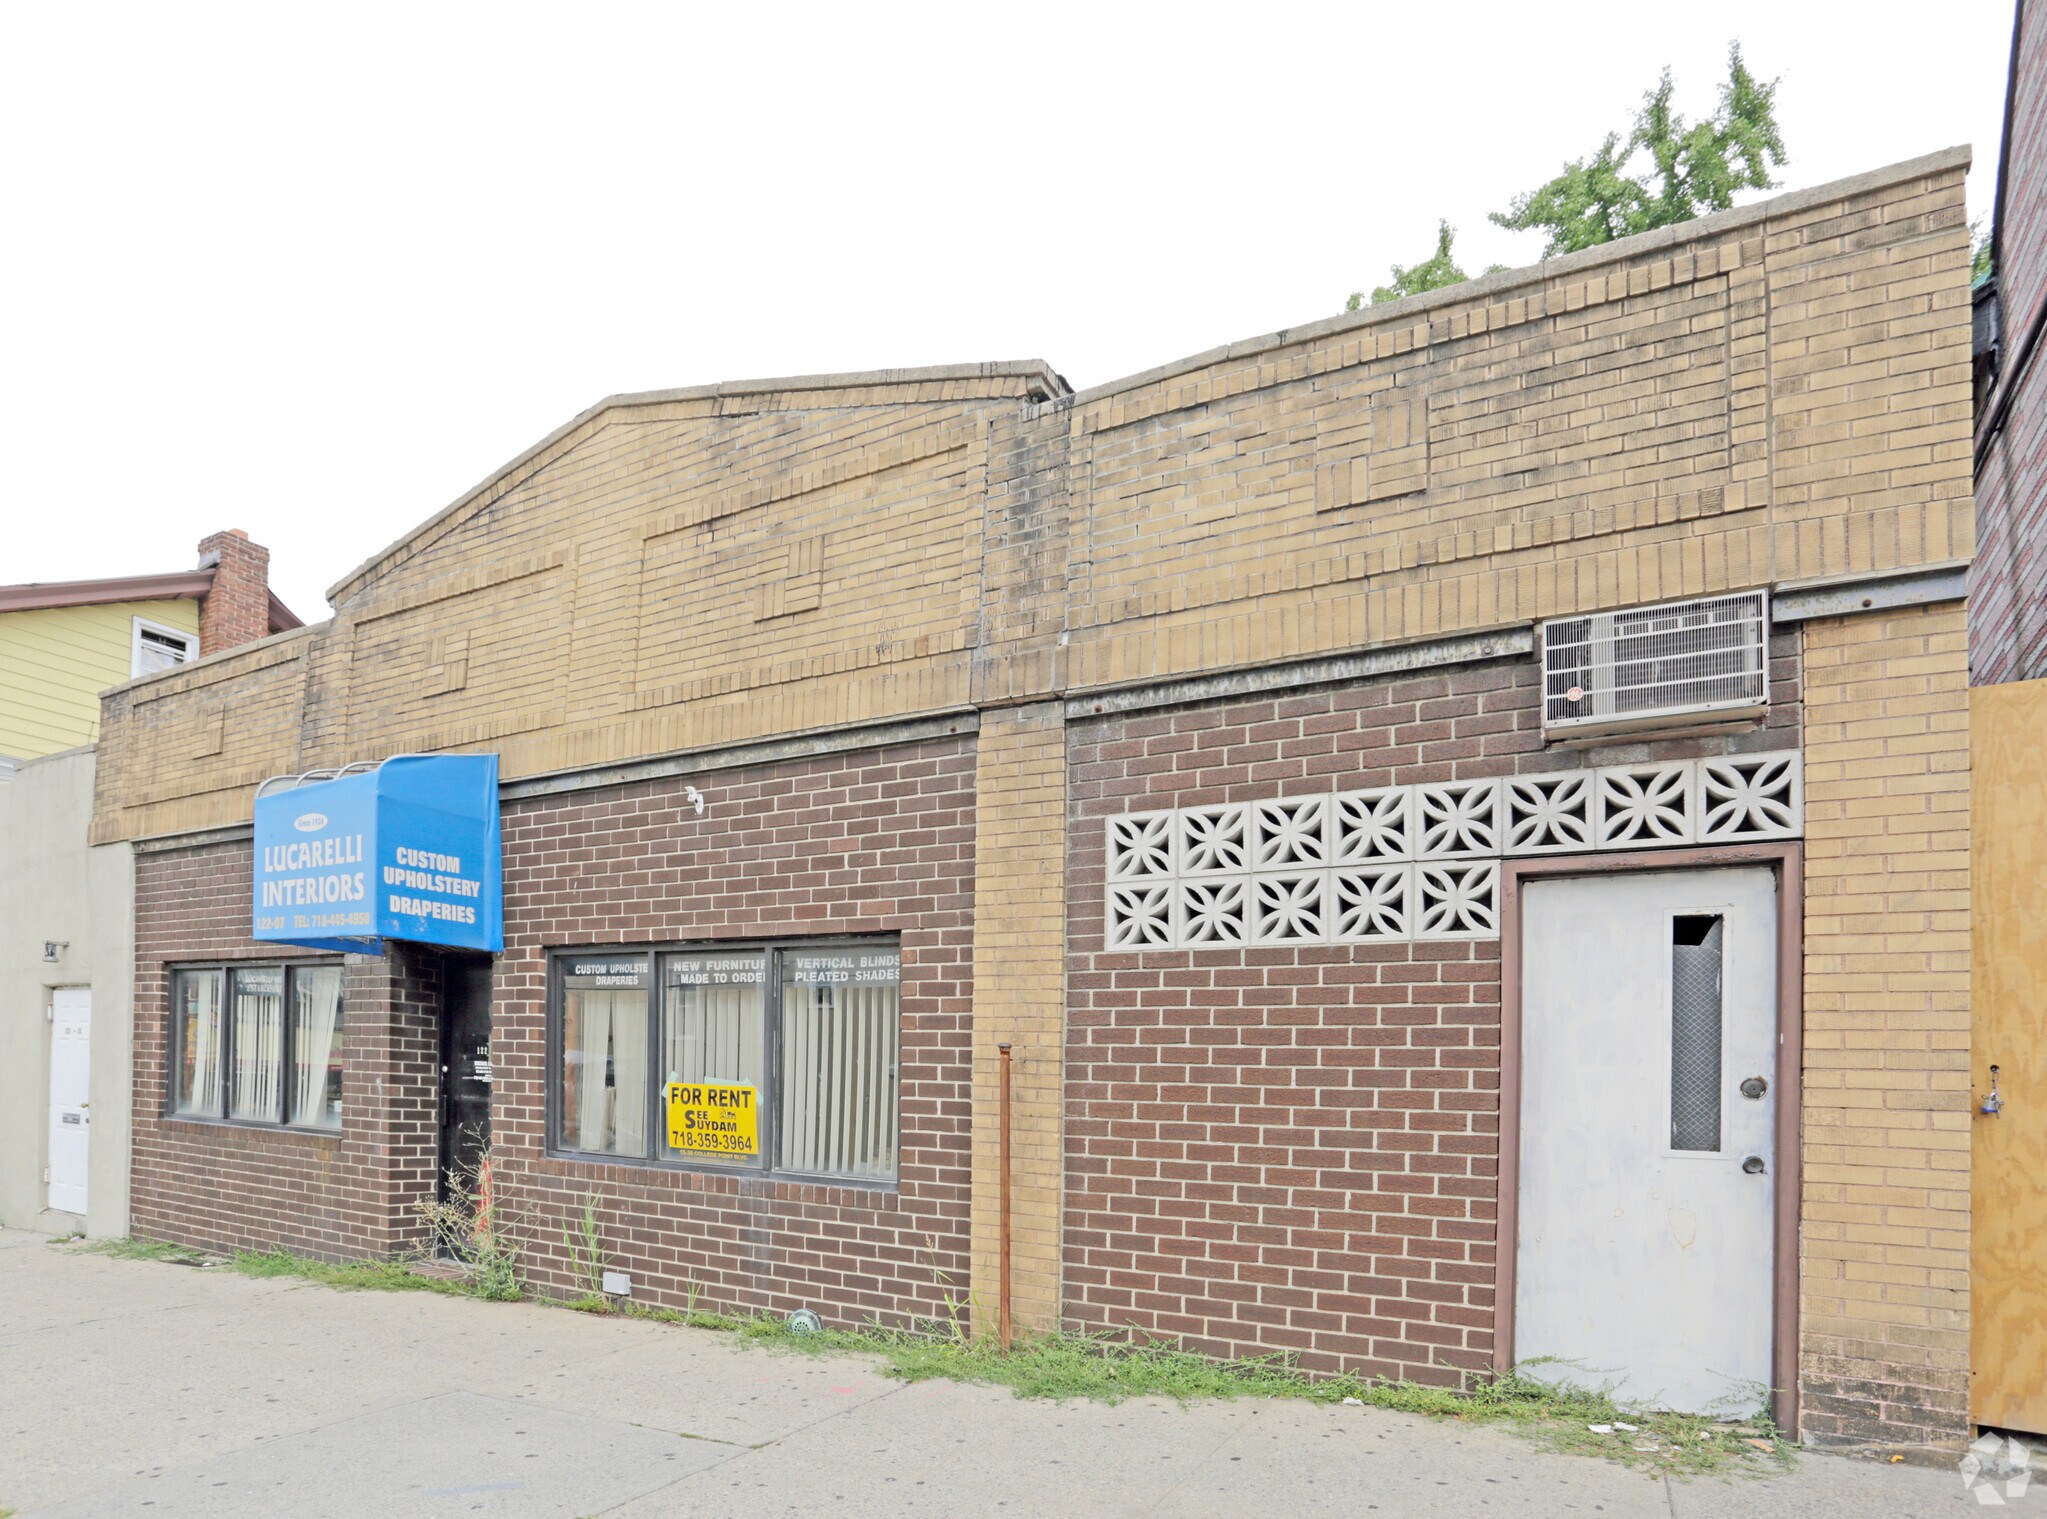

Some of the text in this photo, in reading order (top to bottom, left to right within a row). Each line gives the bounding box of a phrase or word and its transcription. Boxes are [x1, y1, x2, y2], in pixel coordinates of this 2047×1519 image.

[264, 834, 362, 873] LUCARELLI
[396, 846, 460, 874] CUSTOM
[262, 872, 364, 907] INTERIORS
[383, 866, 480, 898] UPHOLSTERY
[389, 894, 475, 924] DRAPERIES
[256, 917, 285, 930] 122-07
[673, 961, 701, 972] NEW
[796, 954, 900, 969] VERTICAL BLINDS
[575, 964, 607, 975] CUSTOM
[794, 971, 849, 982] PLEATED
[595, 975, 639, 986] DRAPERIES
[680, 972, 766, 984] MADE TO ORDE
[671, 1086, 752, 1109] FOR RENT
[672, 1130, 752, 1151] 718-359-3964
[694, 1150, 718, 1158] COLLEGE
